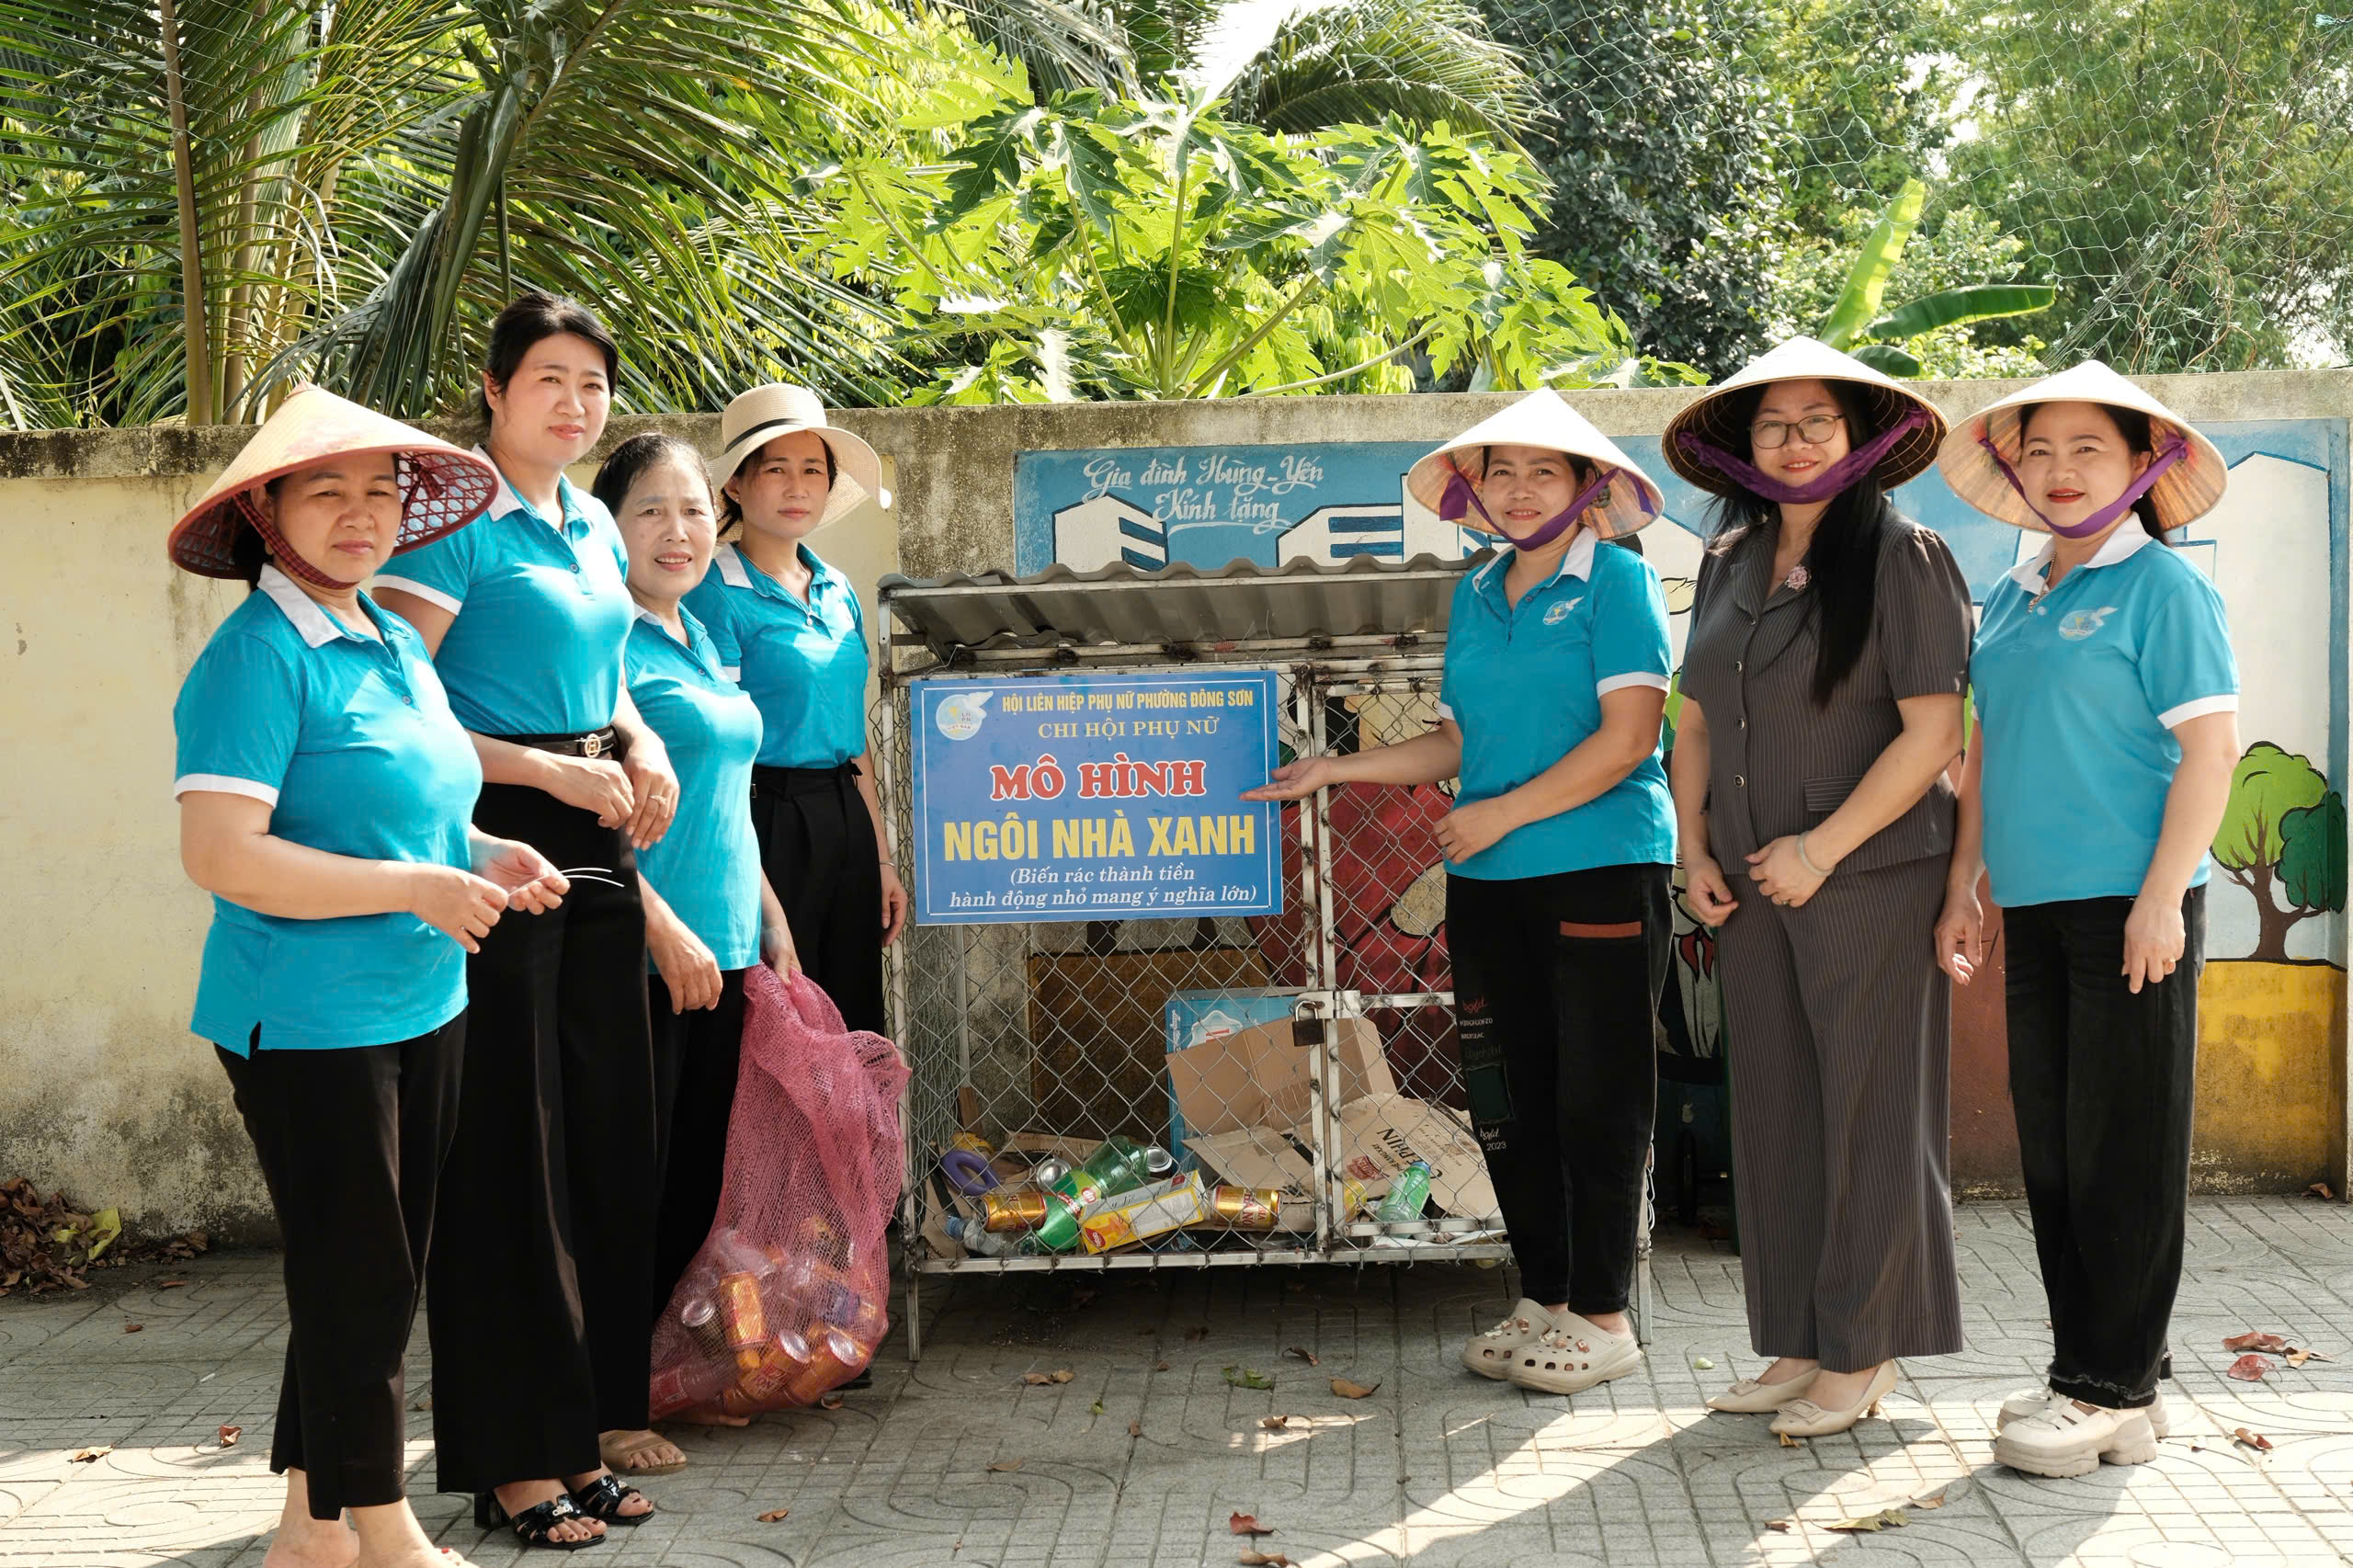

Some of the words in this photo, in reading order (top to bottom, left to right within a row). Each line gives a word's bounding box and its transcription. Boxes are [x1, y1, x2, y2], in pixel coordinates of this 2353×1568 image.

[1082, 457, 1132, 503] Gia
[1140, 456, 1187, 485] đình
[1153, 487, 1216, 523] Kính
[1223, 495, 1292, 535] tặng
[1002, 693, 1023, 715] HỘI
[1026, 692, 1054, 712] LIÊN
[1056, 691, 1085, 714] HIỆP
[1087, 693, 1113, 713] PHỤ
[1116, 690, 1135, 710] NỮ
[1137, 688, 1188, 710] PHƯỜNG
[1189, 688, 1224, 708] ĐÔNG
[1227, 689, 1254, 707] SƠN
[1038, 722, 1079, 738] CHI
[1085, 717, 1126, 741] HỘI
[1131, 720, 1180, 739] PHỤ
[1186, 715, 1221, 735] NỮ
[990, 753, 1066, 801] MÔ
[1077, 752, 1207, 799] HÌNH
[944, 812, 1039, 861] NGÔI
[1051, 809, 1135, 858] NHÀ
[1147, 815, 1256, 857] XANH
[1011, 866, 1059, 886] (Biến
[1063, 867, 1095, 883] rác
[1099, 865, 1153, 882] thành
[1159, 862, 1195, 881] tiền
[949, 891, 995, 907] hành
[1001, 890, 1048, 910] động
[1051, 886, 1087, 904] nhỏ
[1091, 891, 1143, 906] mang
[1146, 887, 1158, 906] ý
[1163, 886, 1215, 905] nghĩa
[1220, 884, 1257, 903] lớn)
[1486, 1141, 1507, 1152] 2023
